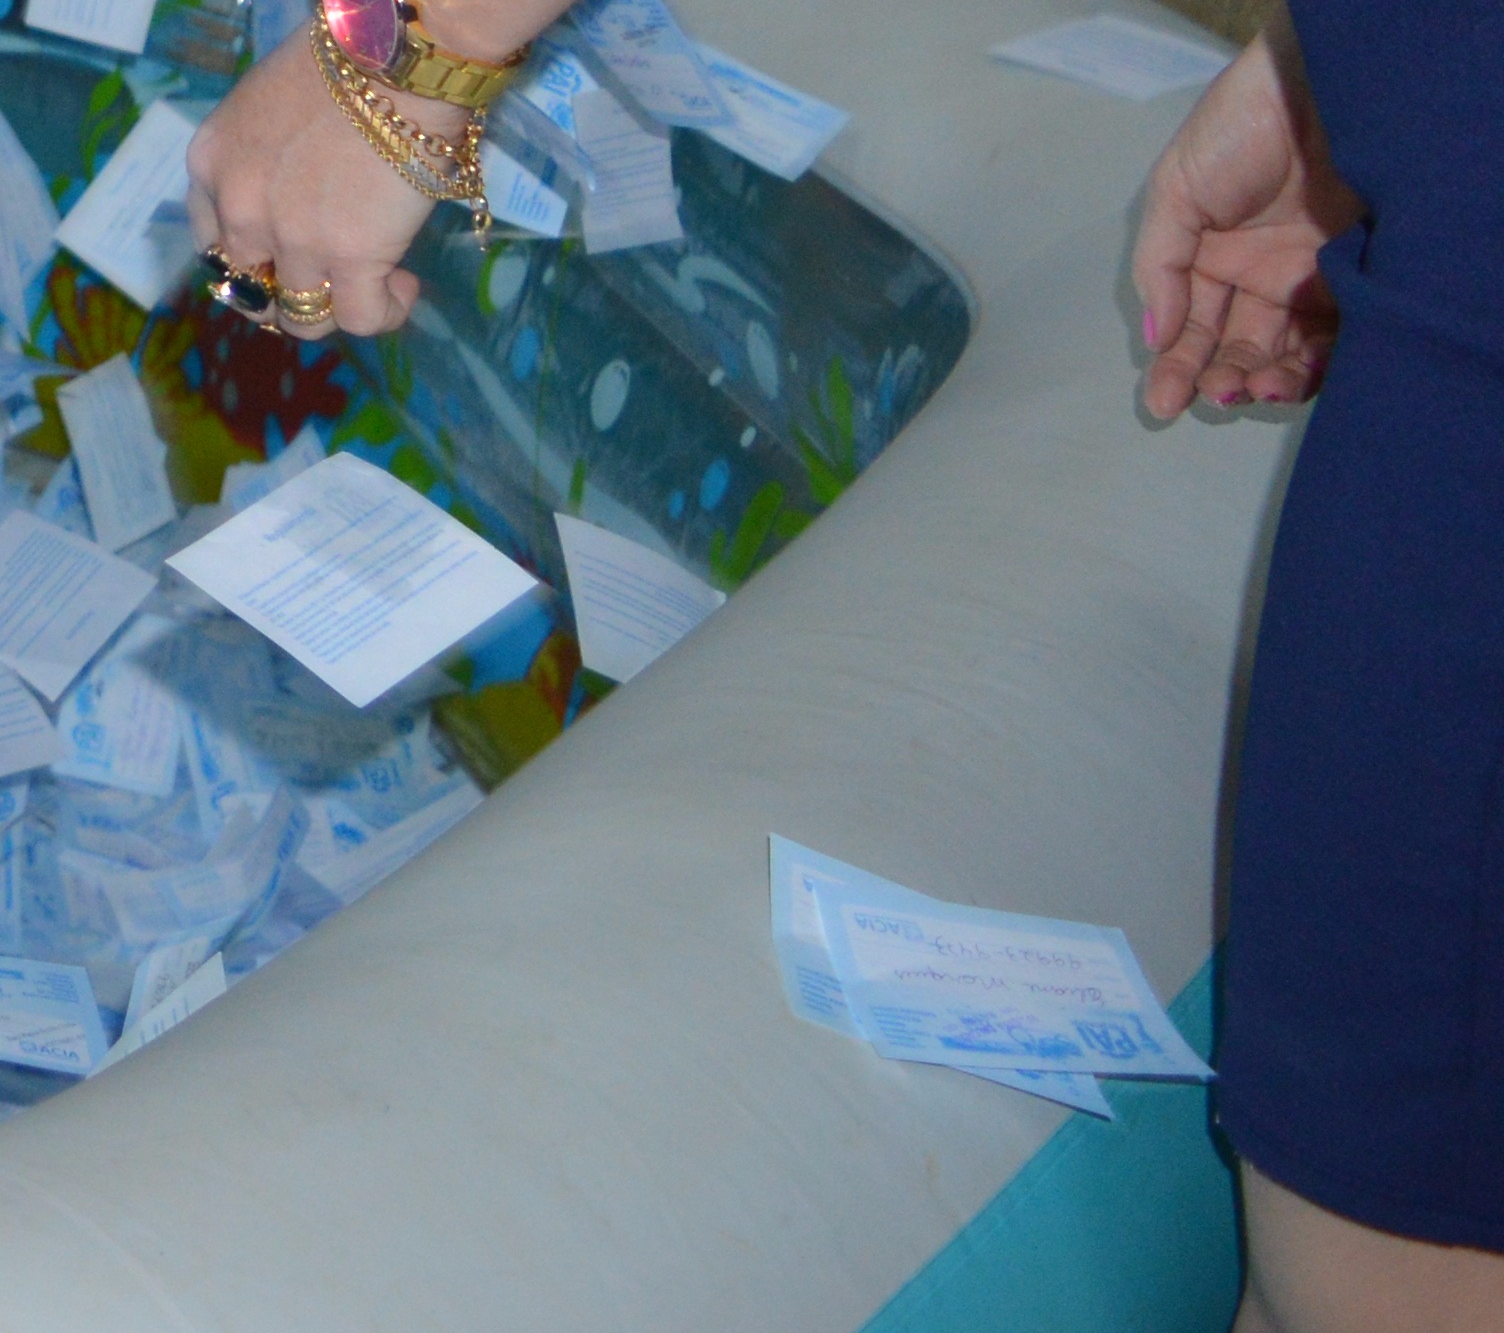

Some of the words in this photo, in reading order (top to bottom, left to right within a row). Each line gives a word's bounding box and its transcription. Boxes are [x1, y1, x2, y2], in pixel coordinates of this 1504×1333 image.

[536, 56, 586, 106] PAI
[852, 915, 899, 934] ACIA
[38, 1045, 80, 1060] ACIA
